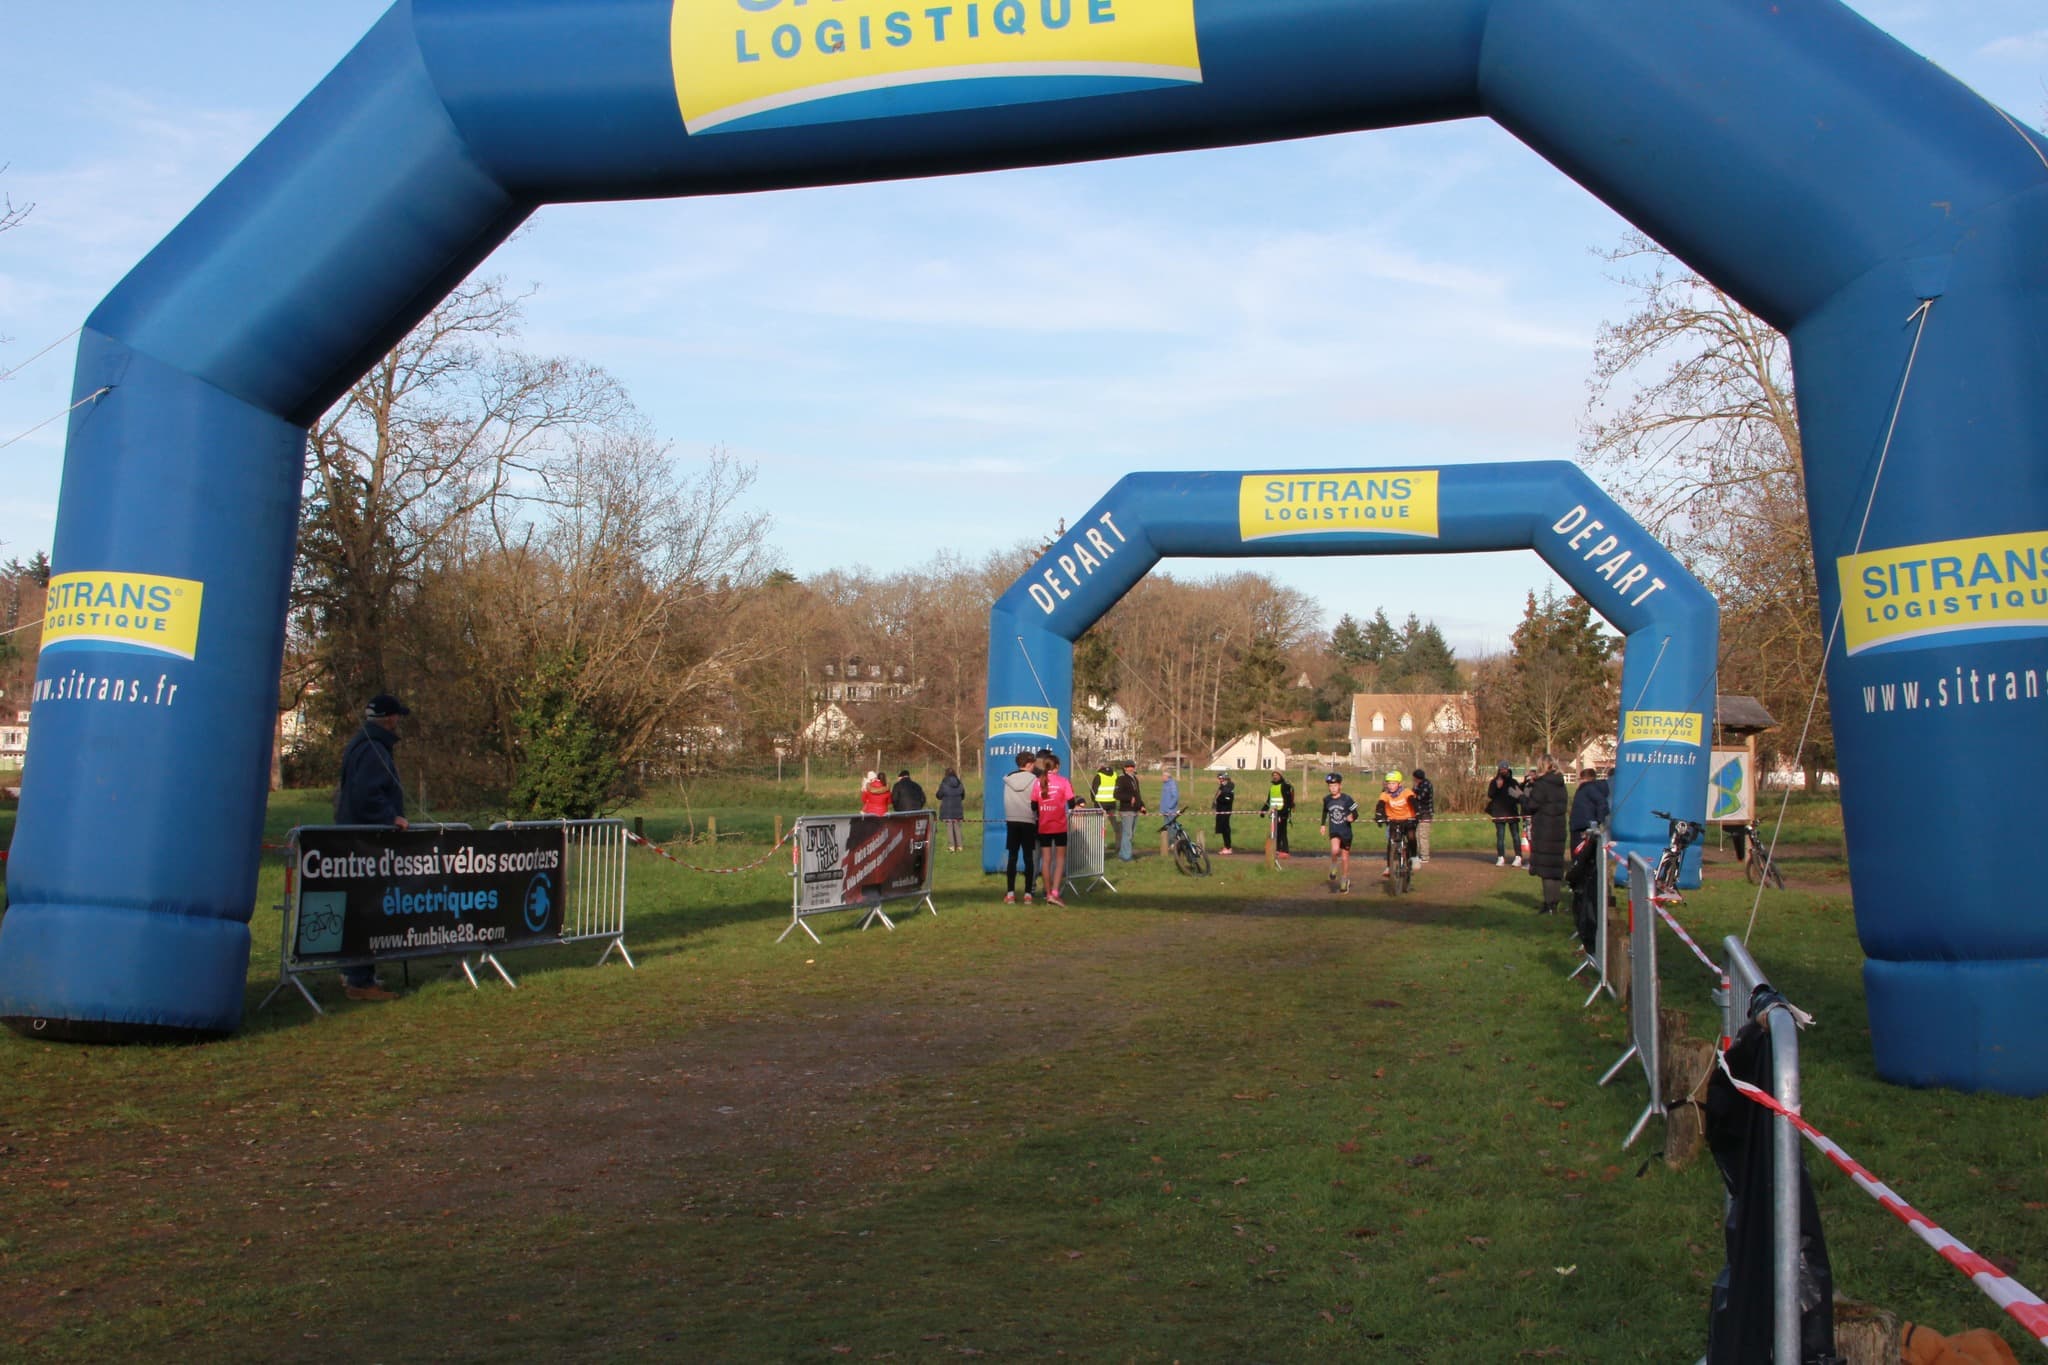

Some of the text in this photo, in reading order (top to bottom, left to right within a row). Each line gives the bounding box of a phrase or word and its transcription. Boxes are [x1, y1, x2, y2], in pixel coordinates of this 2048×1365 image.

[736, 0, 1116, 63] LOGISTIQUE
[1264, 478, 1412, 503] SITRANS
[1264, 505, 1410, 521] LOGISTIQUE
[1028, 511, 1127, 615] DEPART
[1551, 505, 1667, 607] DEPART
[47, 581, 172, 613] SITRANS
[1866, 587, 2048, 623] LOGISTIQU
[1862, 666, 2048, 713] www.sitran
[993, 710, 1049, 722] SITRANS
[1632, 715, 1694, 728] SITRANS
[1626, 751, 1697, 765] www.sitrans.fr
[806, 824, 836, 852] FUN
[302, 846, 560, 879] Centre d'essai vélos scooters
[382, 885, 499, 919] électriques
[369, 923, 507, 950] www.funbike28.com
